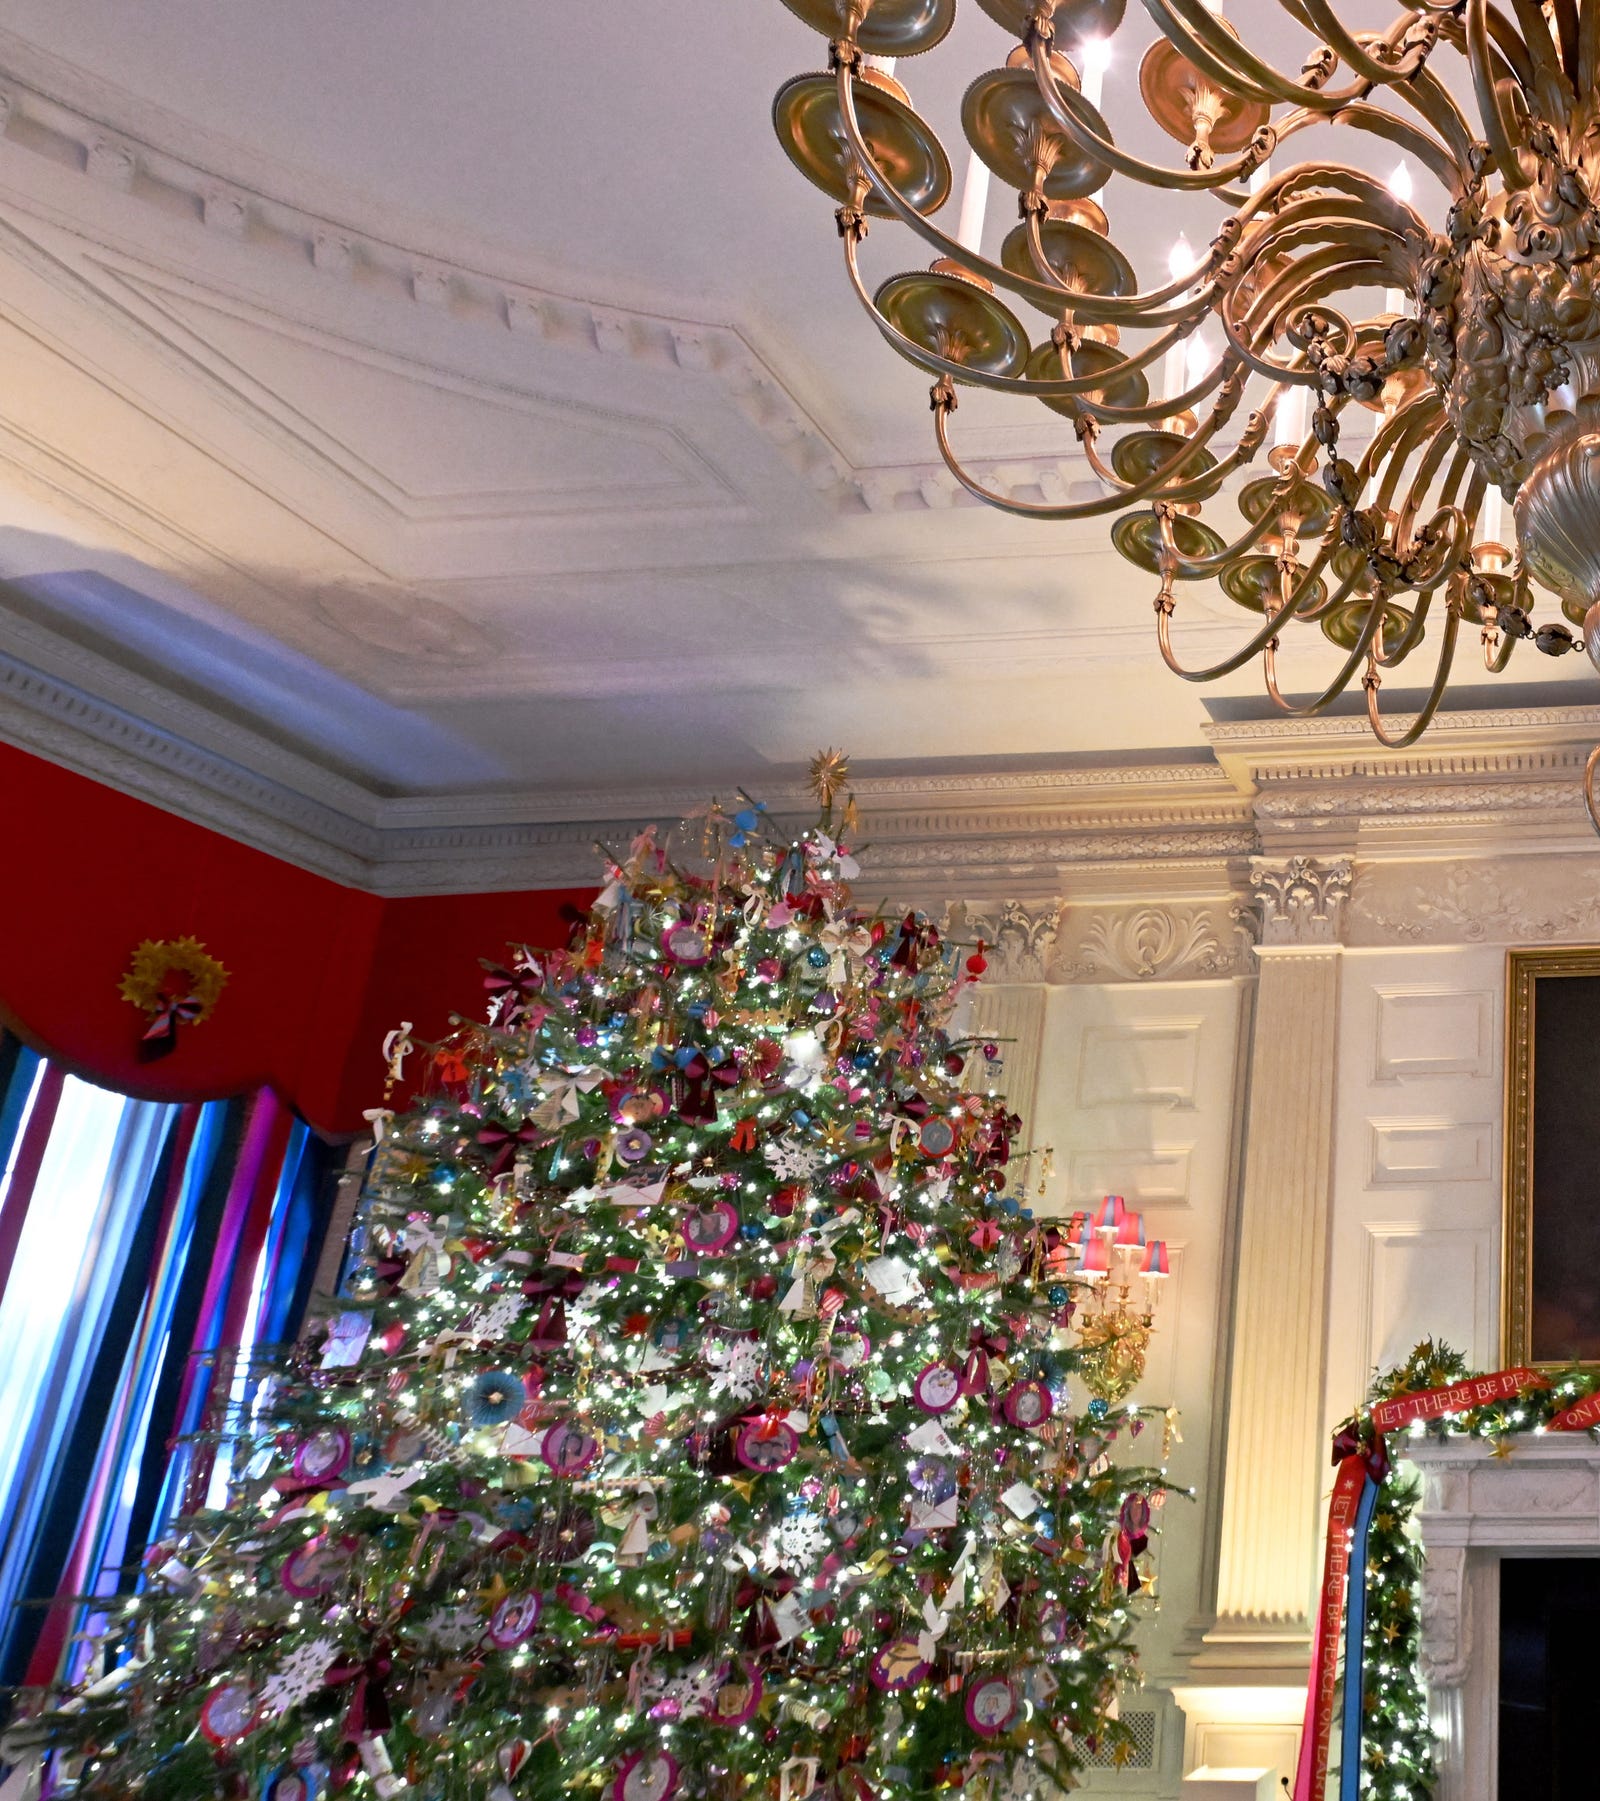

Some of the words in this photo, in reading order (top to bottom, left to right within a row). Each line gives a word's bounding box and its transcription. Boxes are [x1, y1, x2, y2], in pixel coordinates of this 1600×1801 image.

[1380, 1402, 1405, 1425] LET
[1409, 1387, 1471, 1415] THERE
[1475, 1380, 1498, 1399] BE
[1502, 1371, 1541, 1392] PEA
[1566, 1404, 1592, 1425] ON
[1333, 1495, 1352, 1525] LET
[1327, 1529, 1346, 1597] THERE
[1327, 1604, 1340, 1627] BE
[1321, 1634, 1338, 1701] PEACE
[1319, 1708, 1331, 1738] ON
